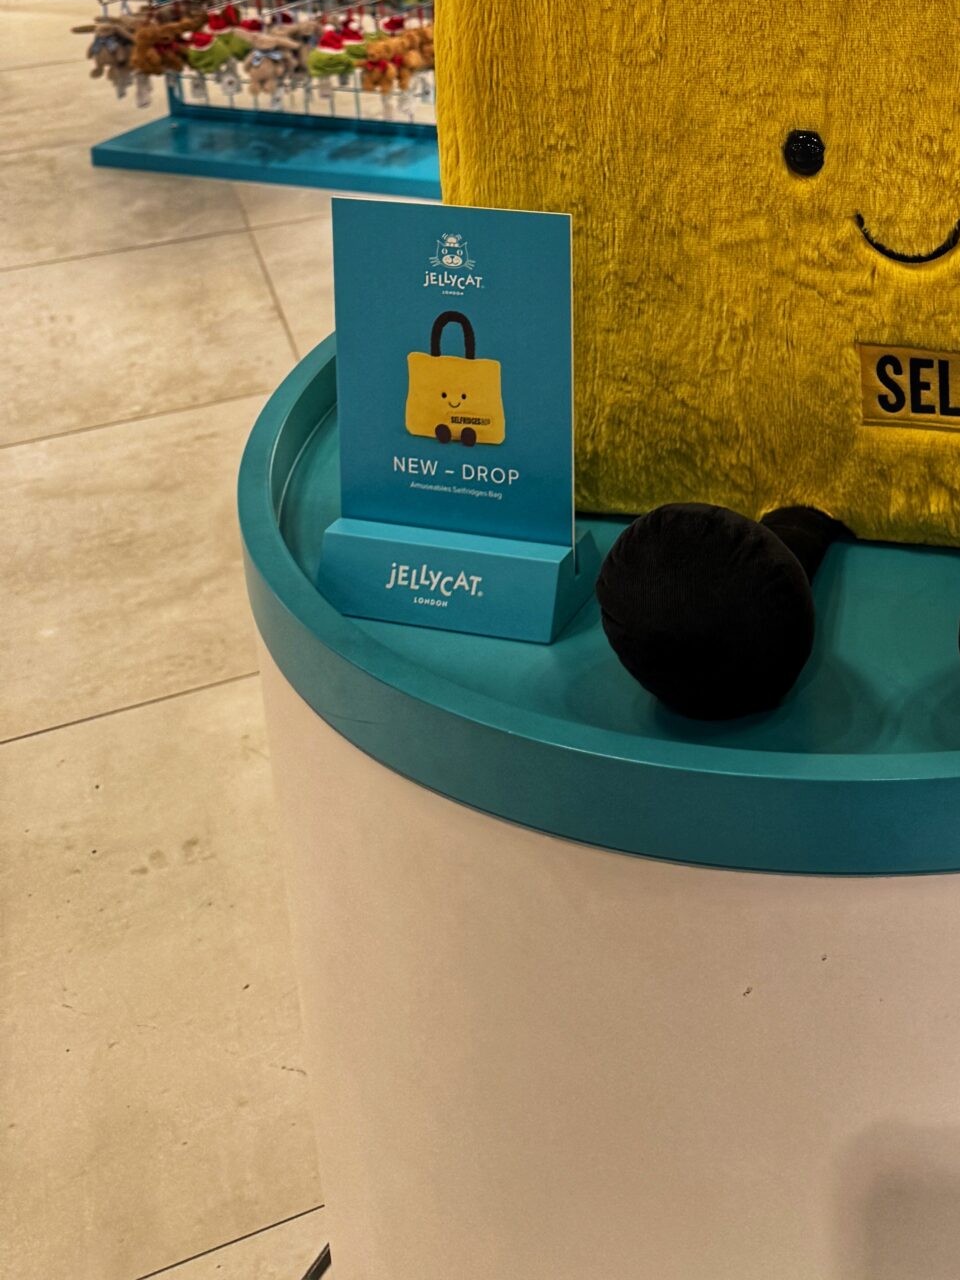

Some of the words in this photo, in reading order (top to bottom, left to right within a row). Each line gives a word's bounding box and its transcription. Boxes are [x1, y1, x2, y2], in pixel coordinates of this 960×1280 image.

[393, 456, 438, 476] NEW
[462, 463, 520, 485] DROP
[410, 481, 452, 493] Amuseables
[452, 486, 488, 497] Selfridges
[488, 490, 503, 500] Bag
[413, 596, 448, 608] LONDON
